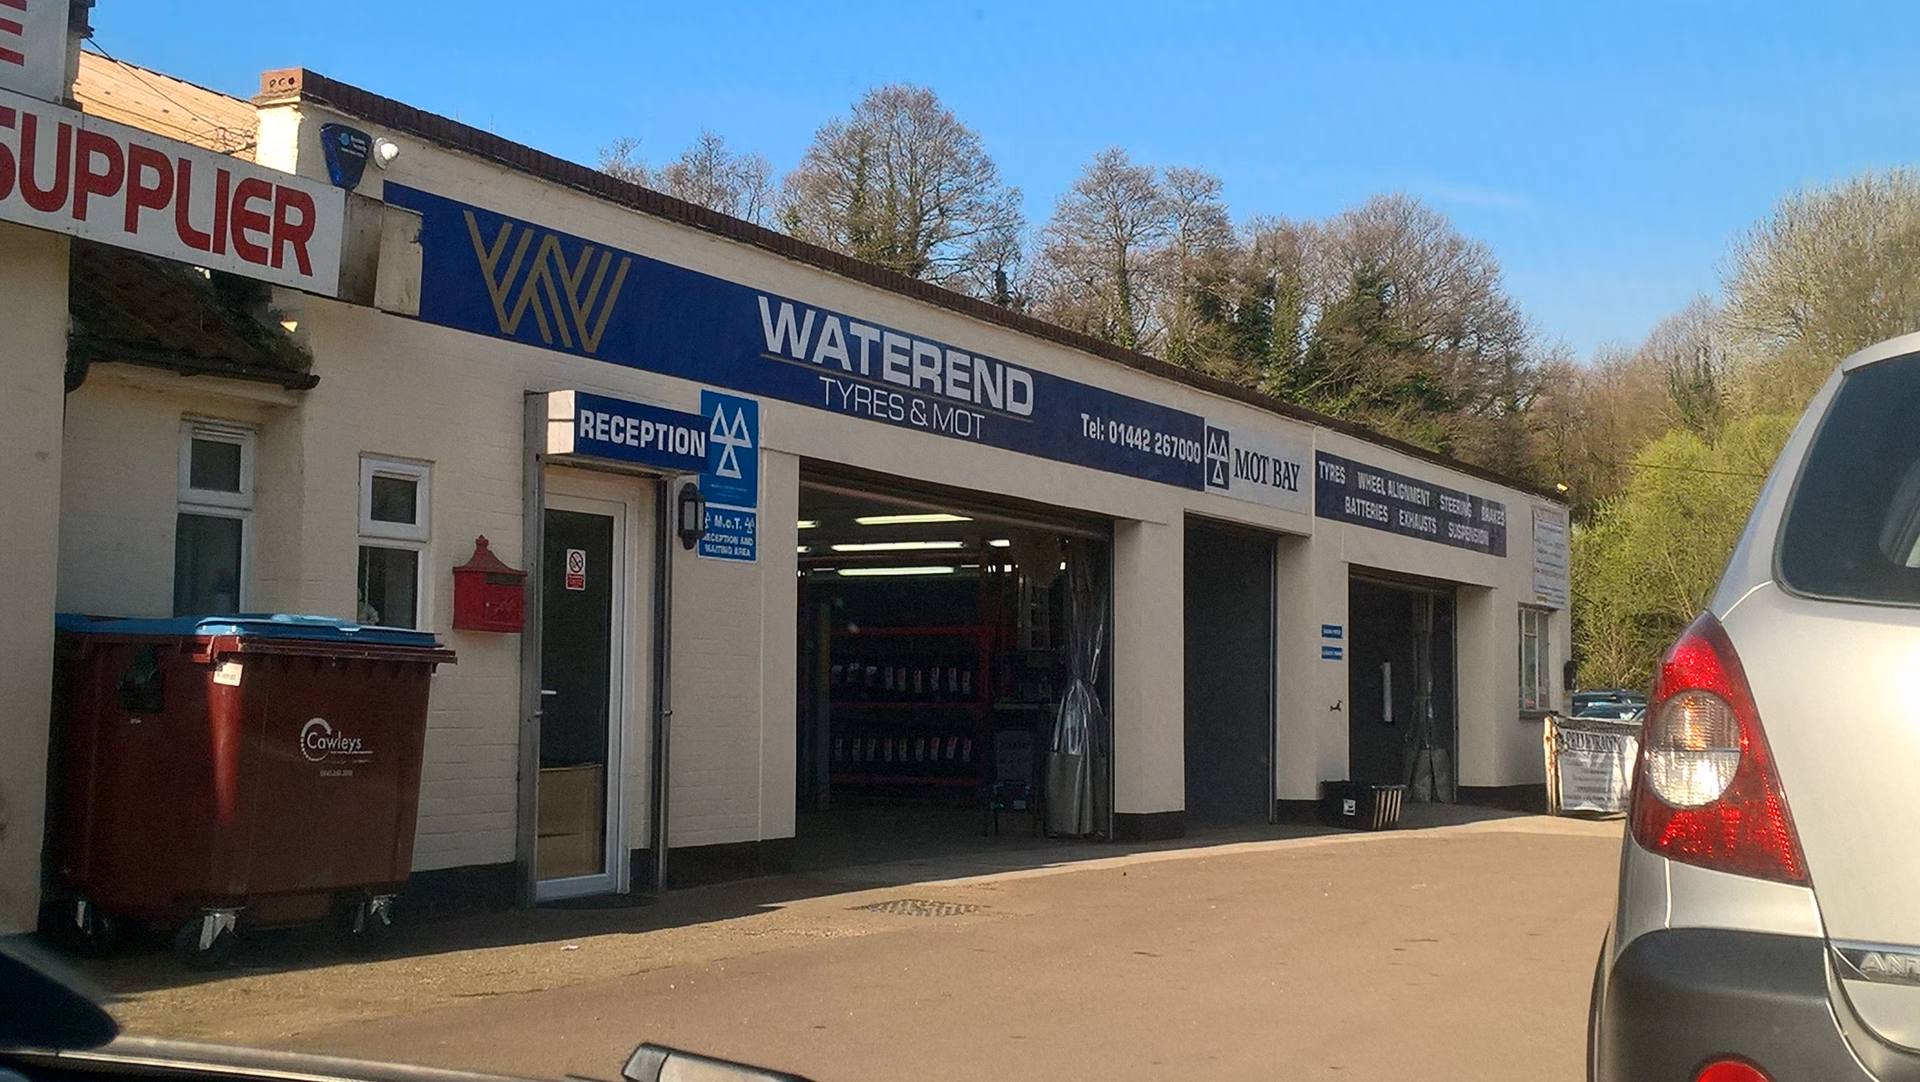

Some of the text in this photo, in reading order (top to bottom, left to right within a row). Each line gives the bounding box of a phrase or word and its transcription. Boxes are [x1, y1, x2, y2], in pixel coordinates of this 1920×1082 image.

[758, 295, 1034, 416] WATEREND
[819, 375, 985, 439] TYRES & MOT
[579, 408, 706, 458] RECEPTION
[1080, 412, 1201, 464] Tel: 01442 267000
[1233, 448, 1300, 492] MOT BAY
[1318, 460, 1505, 527] TYRES WHEEL ALIGNMENT STEERING BRAKES
[714, 514, 743, 530] M.o.T.
[740, 536, 754, 547] AND
[1344, 495, 1489, 546] BATTERIES EXHAUSTS SUSPENSION
[704, 543, 751, 557] WAITING AREA
[306, 730, 362, 755] Cawleys
